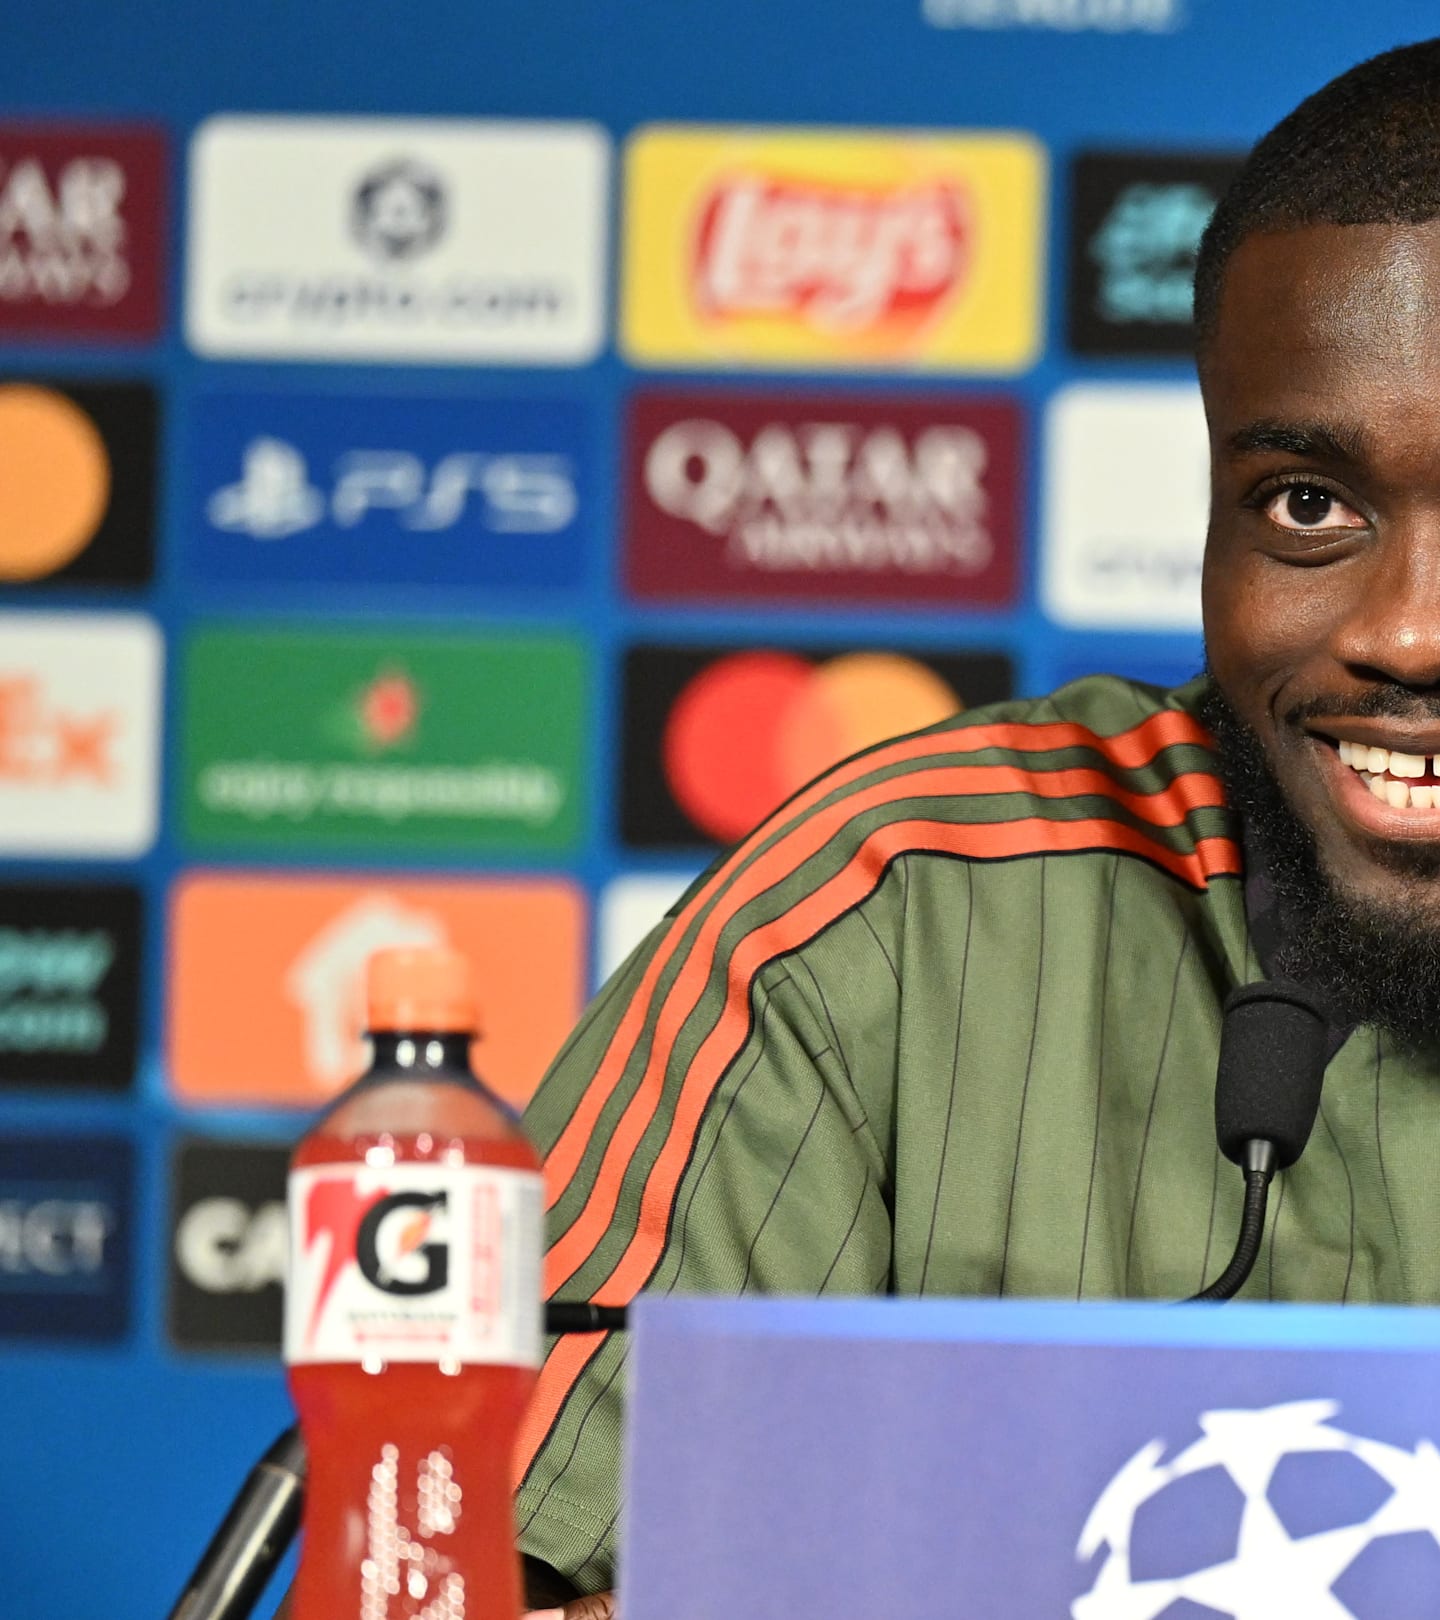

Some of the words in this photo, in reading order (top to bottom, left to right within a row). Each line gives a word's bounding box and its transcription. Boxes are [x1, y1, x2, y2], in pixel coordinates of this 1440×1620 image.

[650, 427, 982, 528] QATAR
[733, 515, 987, 568] AIRWAYS
[356, 1189, 450, 1297] G
